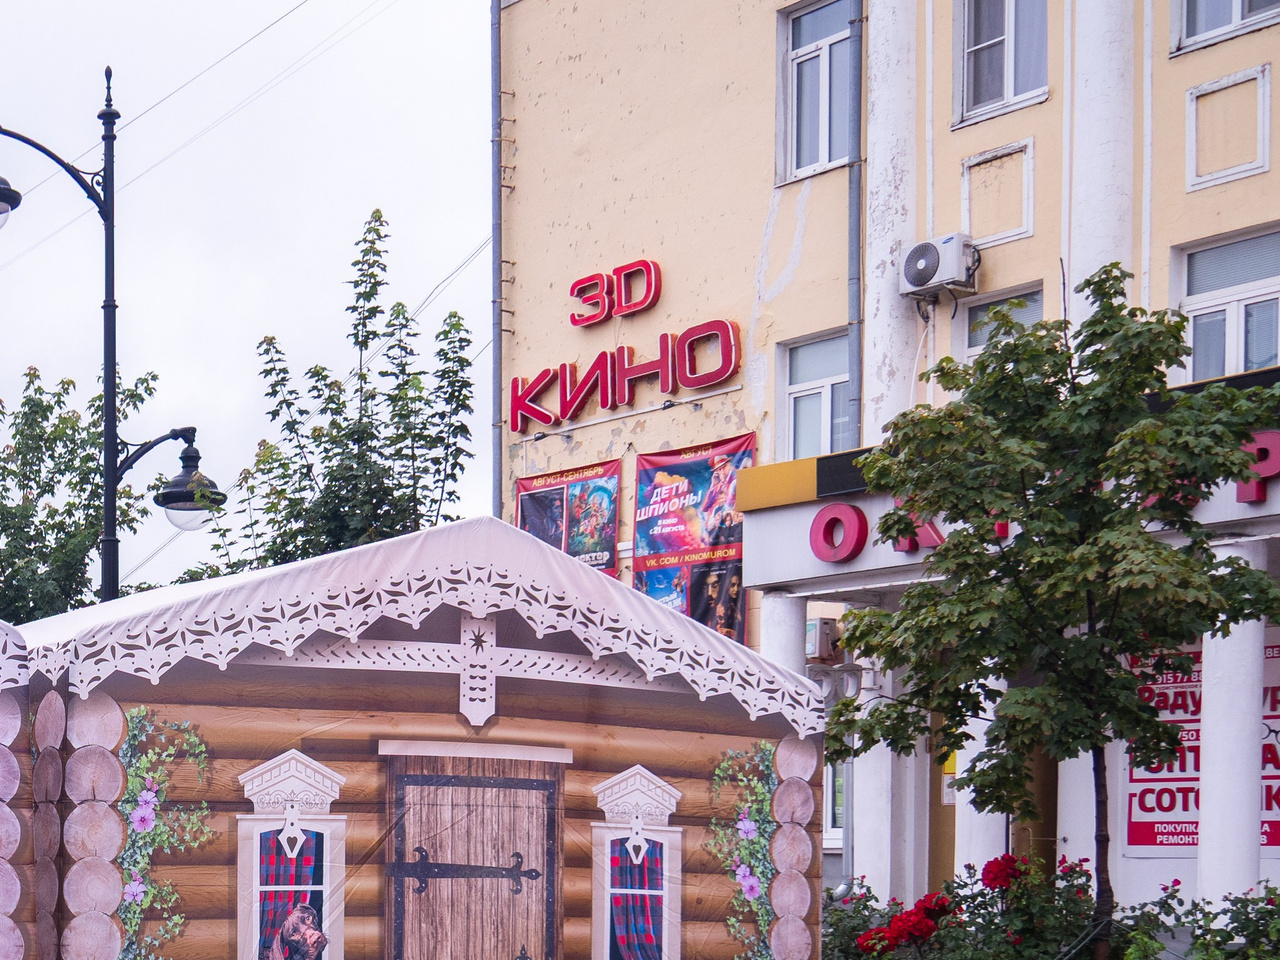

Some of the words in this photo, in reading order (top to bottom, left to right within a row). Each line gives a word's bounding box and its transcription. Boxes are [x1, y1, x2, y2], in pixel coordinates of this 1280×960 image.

[570, 260, 662, 328] 3D
[510, 319, 741, 433] КИНО
[680, 446, 712, 459] АВГУСТ
[532, 466, 604, 487] АВГУСТ-СЕНТЯБРЬ
[650, 479, 689, 504] ДЕТИ
[636, 490, 702, 521] ШПИОНЫ
[660, 557, 679, 565] COM
[684, 548, 736, 562] KINOMUROM
[1137, 686, 1202, 716] Раду
[1156, 834, 1199, 844] РЕМОНТ
